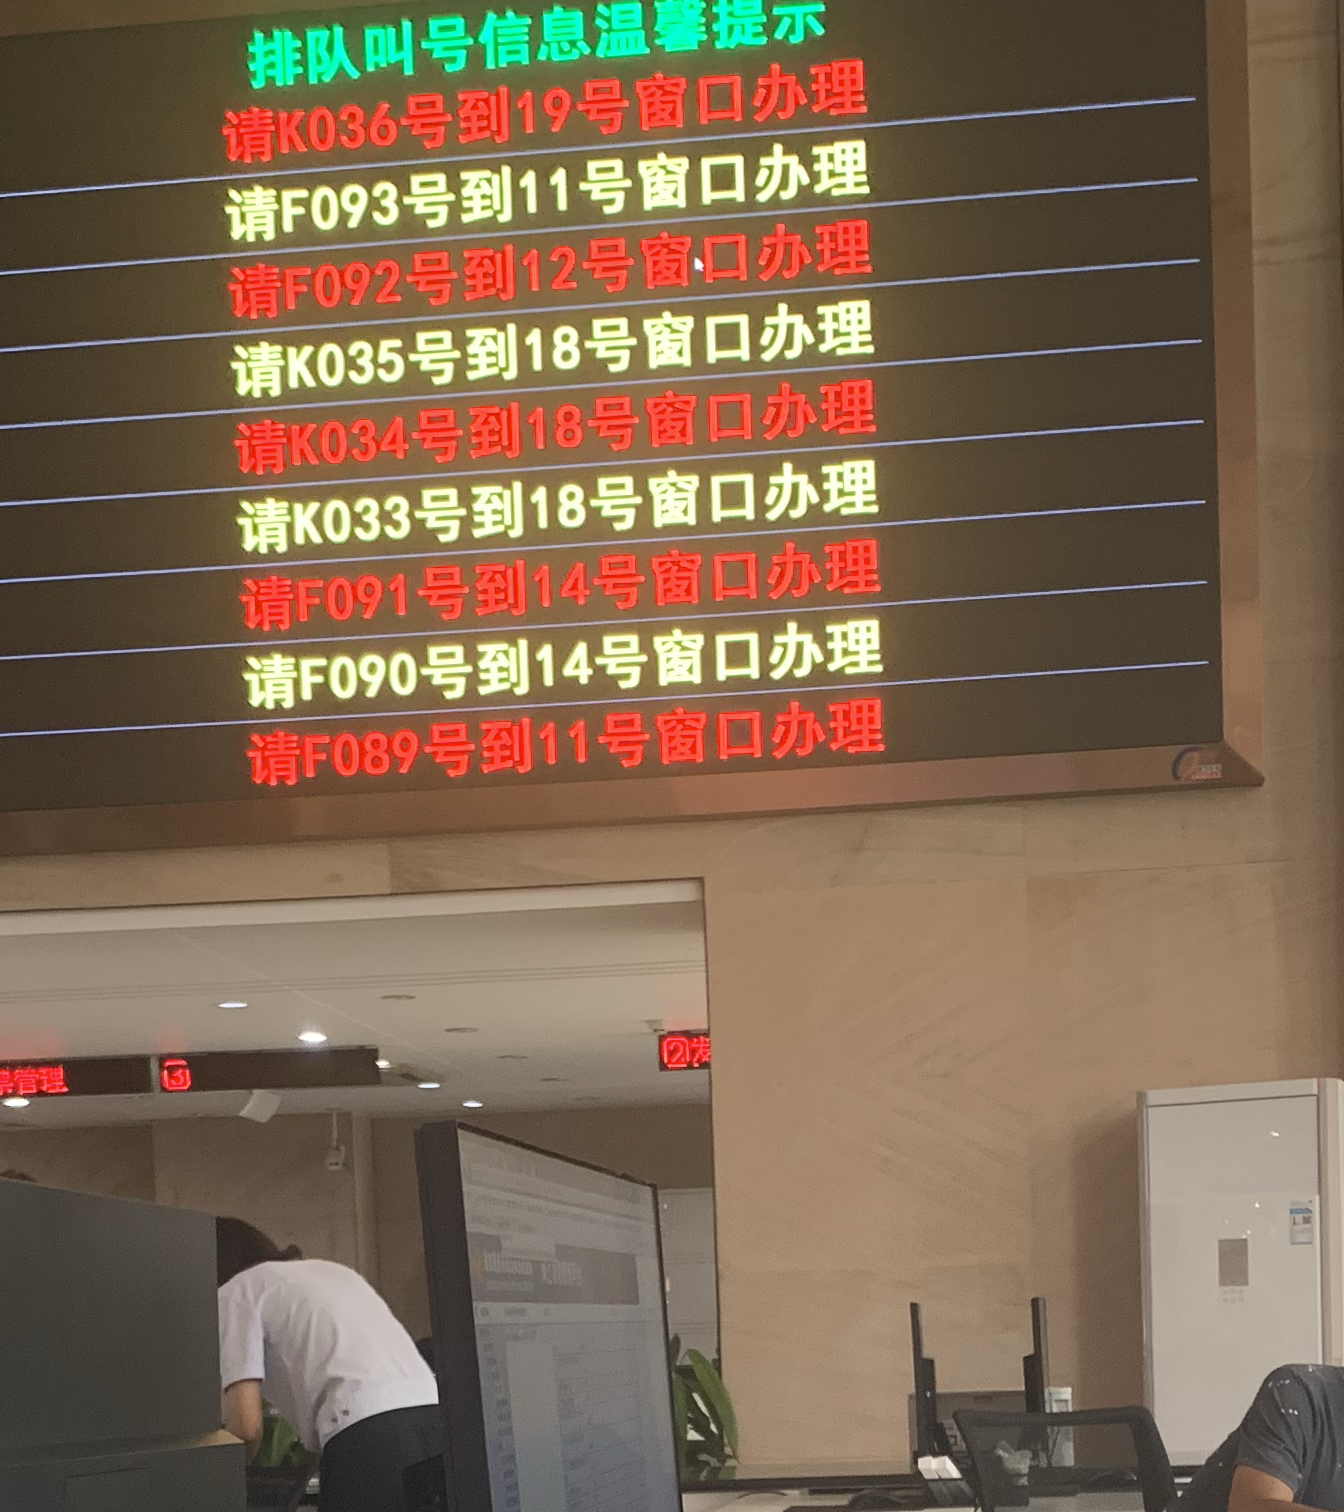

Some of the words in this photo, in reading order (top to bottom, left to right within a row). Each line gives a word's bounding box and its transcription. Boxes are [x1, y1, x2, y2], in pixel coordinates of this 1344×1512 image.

[247, 0, 826, 88] 排队叫号信息温馨提示
[223, 59, 866, 162] 请K036号到19号窗口办理
[226, 141, 868, 240] 请F093号到11号窗口办理
[229, 220, 871, 318] 请F092号到12号窗口办理
[232, 301, 873, 396] 请K035号到18号窗口办理
[235, 379, 875, 474] 请K034号到18号窗口办理
[239, 460, 877, 552] 请K033号到18号窗口办理
[241, 538, 880, 630] 请F091号到14号窗口办理
[245, 620, 881, 708] 请F090号到14号窗口办理
[248, 698, 884, 785] 请F089号到11号窗口办理
